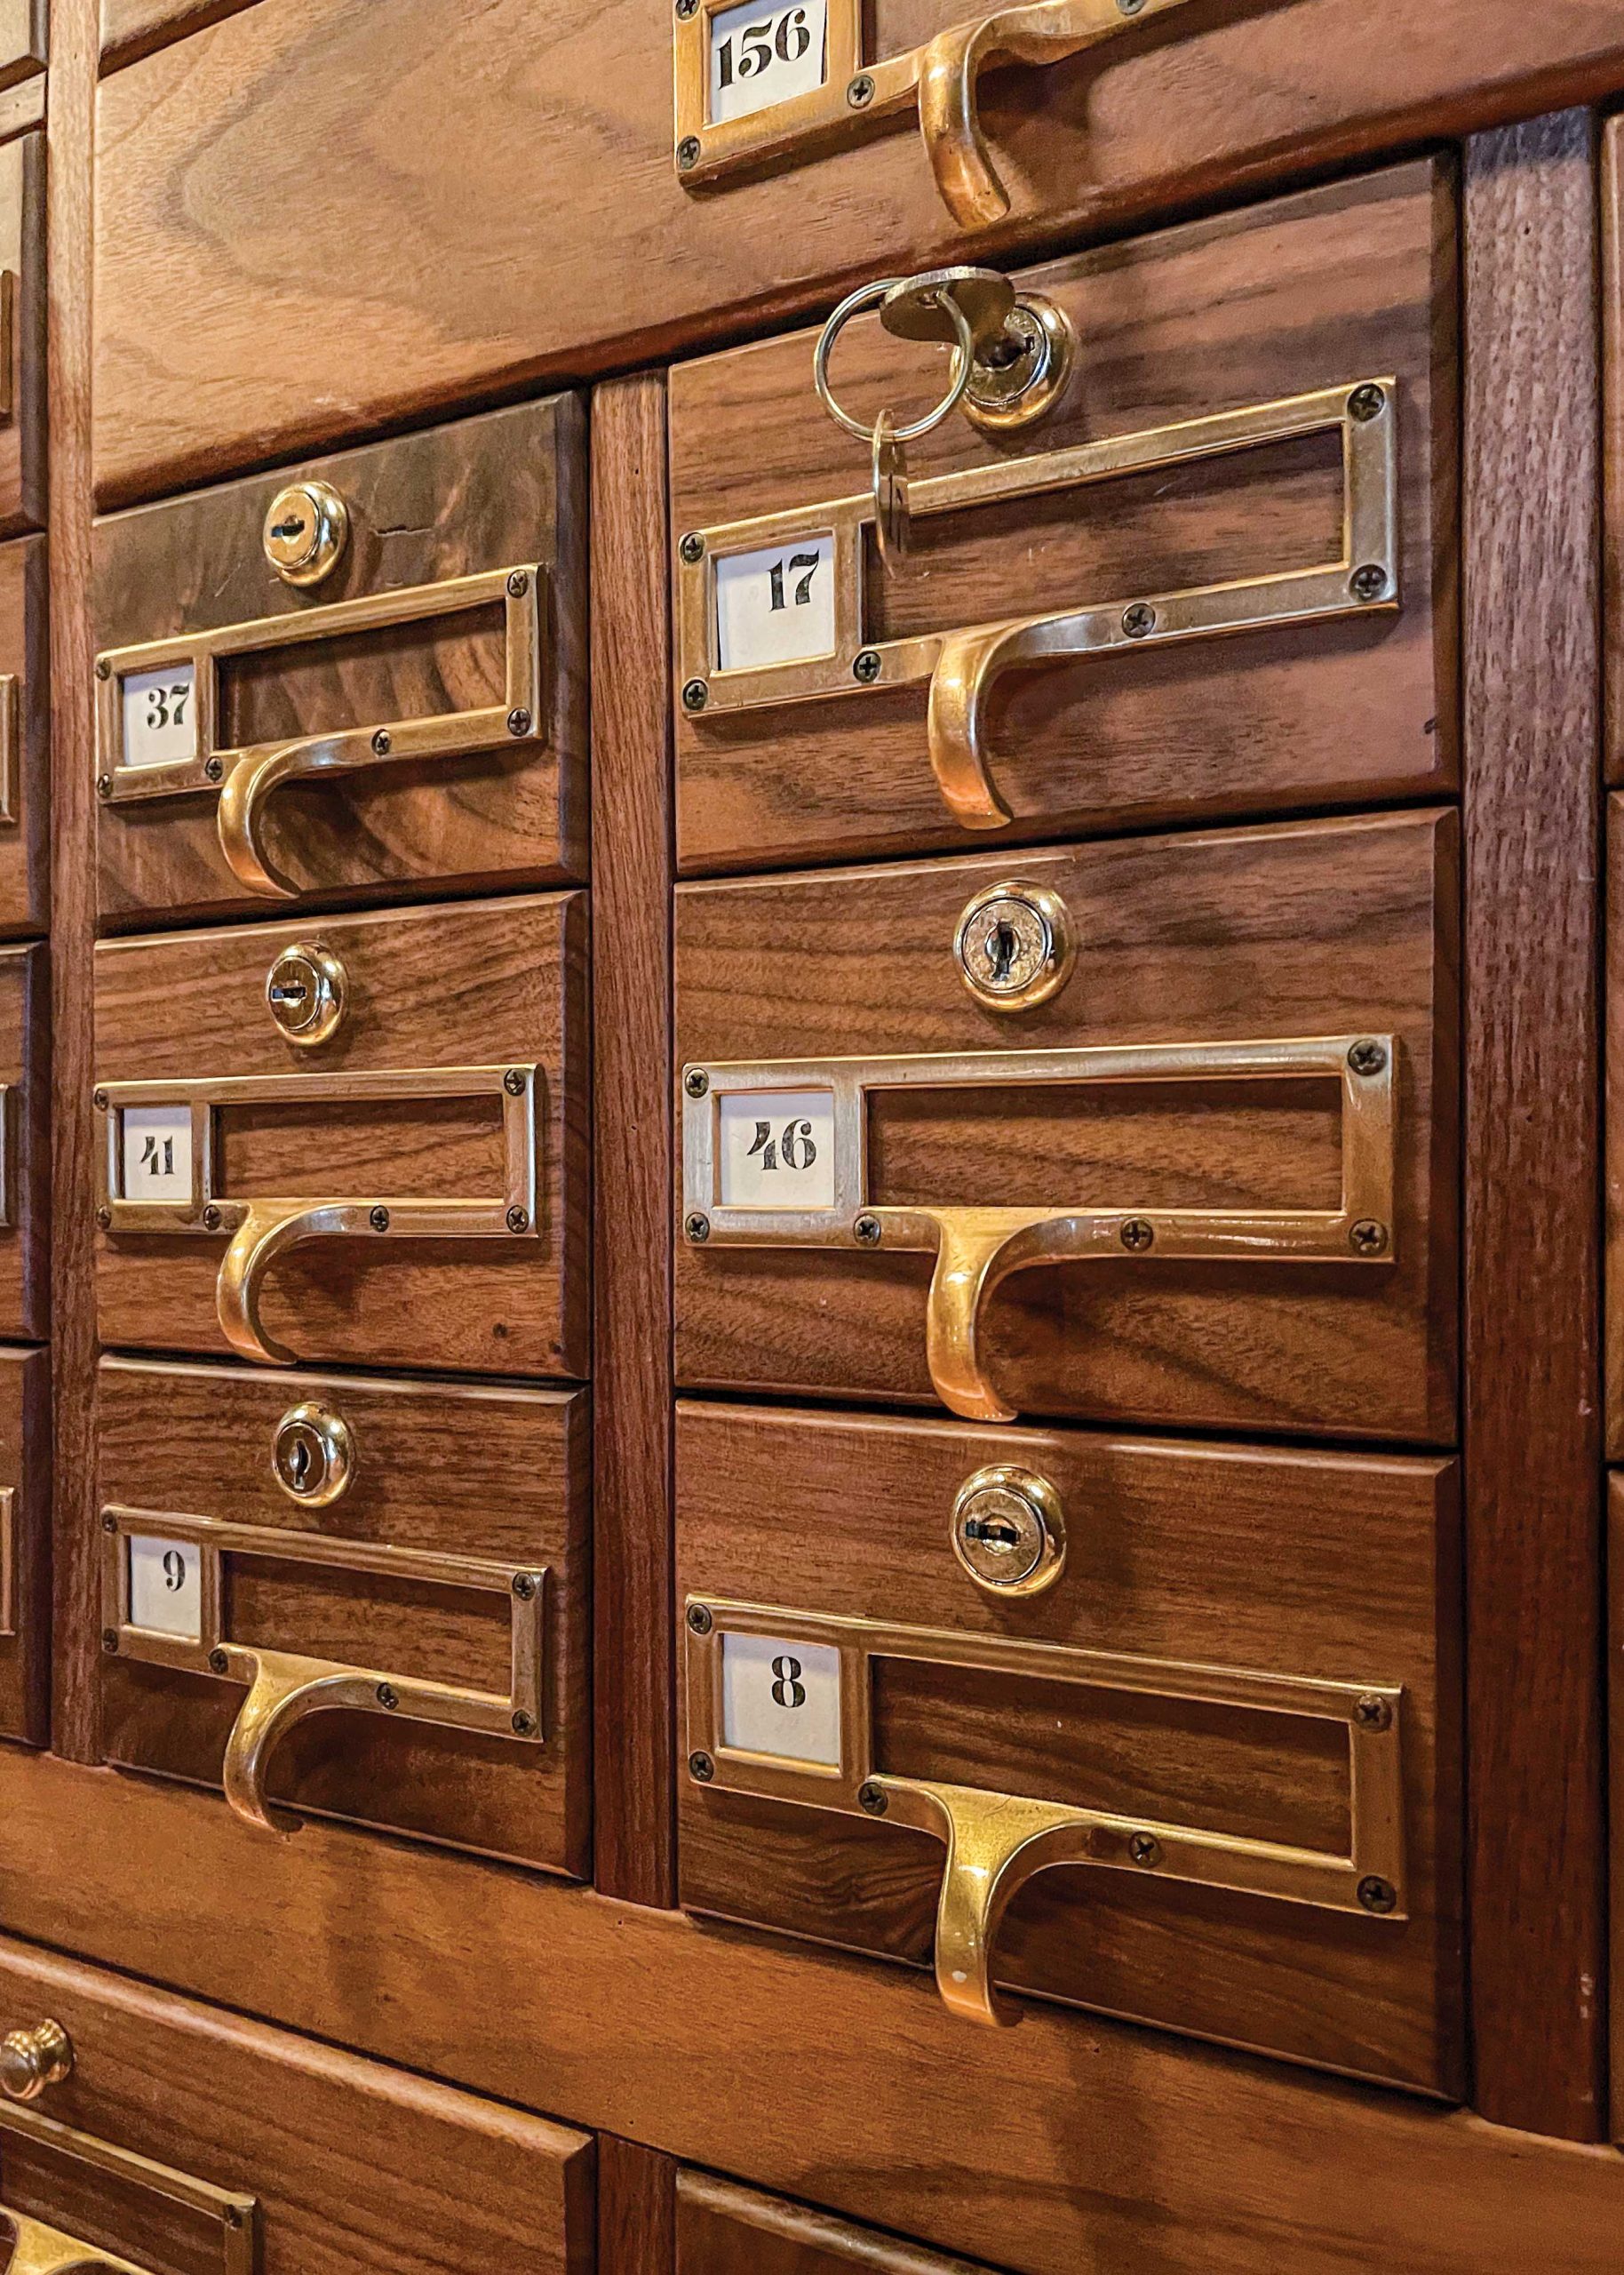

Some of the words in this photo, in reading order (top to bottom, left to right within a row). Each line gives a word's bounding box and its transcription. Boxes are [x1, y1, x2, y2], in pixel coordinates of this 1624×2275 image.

[718, 8, 810, 91] 156
[767, 549, 820, 611] 17
[147, 683, 190, 730] 37
[140, 1137, 174, 1175] 41
[746, 1119, 816, 1170] 46
[163, 1550, 186, 1592] 9
[771, 1656, 806, 1708] 8
